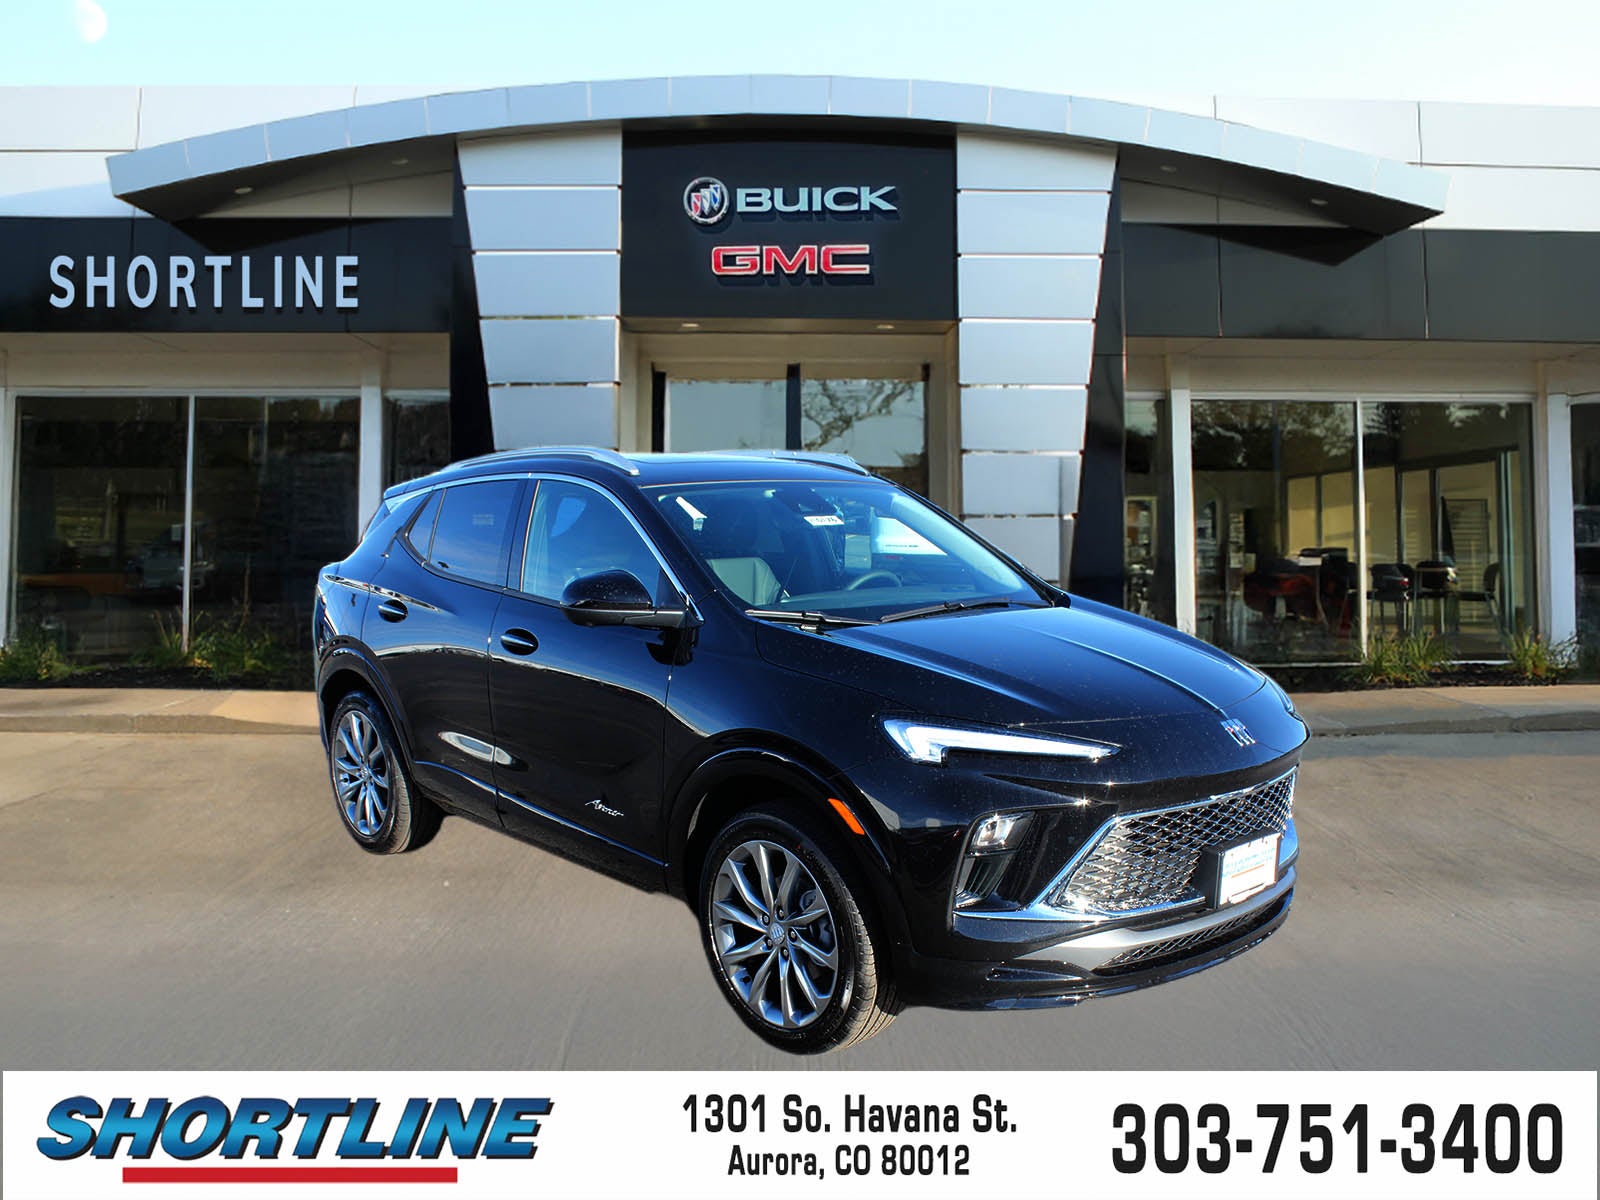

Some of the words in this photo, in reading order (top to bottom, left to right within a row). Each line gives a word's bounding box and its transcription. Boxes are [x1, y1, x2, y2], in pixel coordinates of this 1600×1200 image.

[736, 186, 898, 212] BUICK
[711, 244, 870, 275] GMC
[49, 255, 359, 309] SHORTLINE
